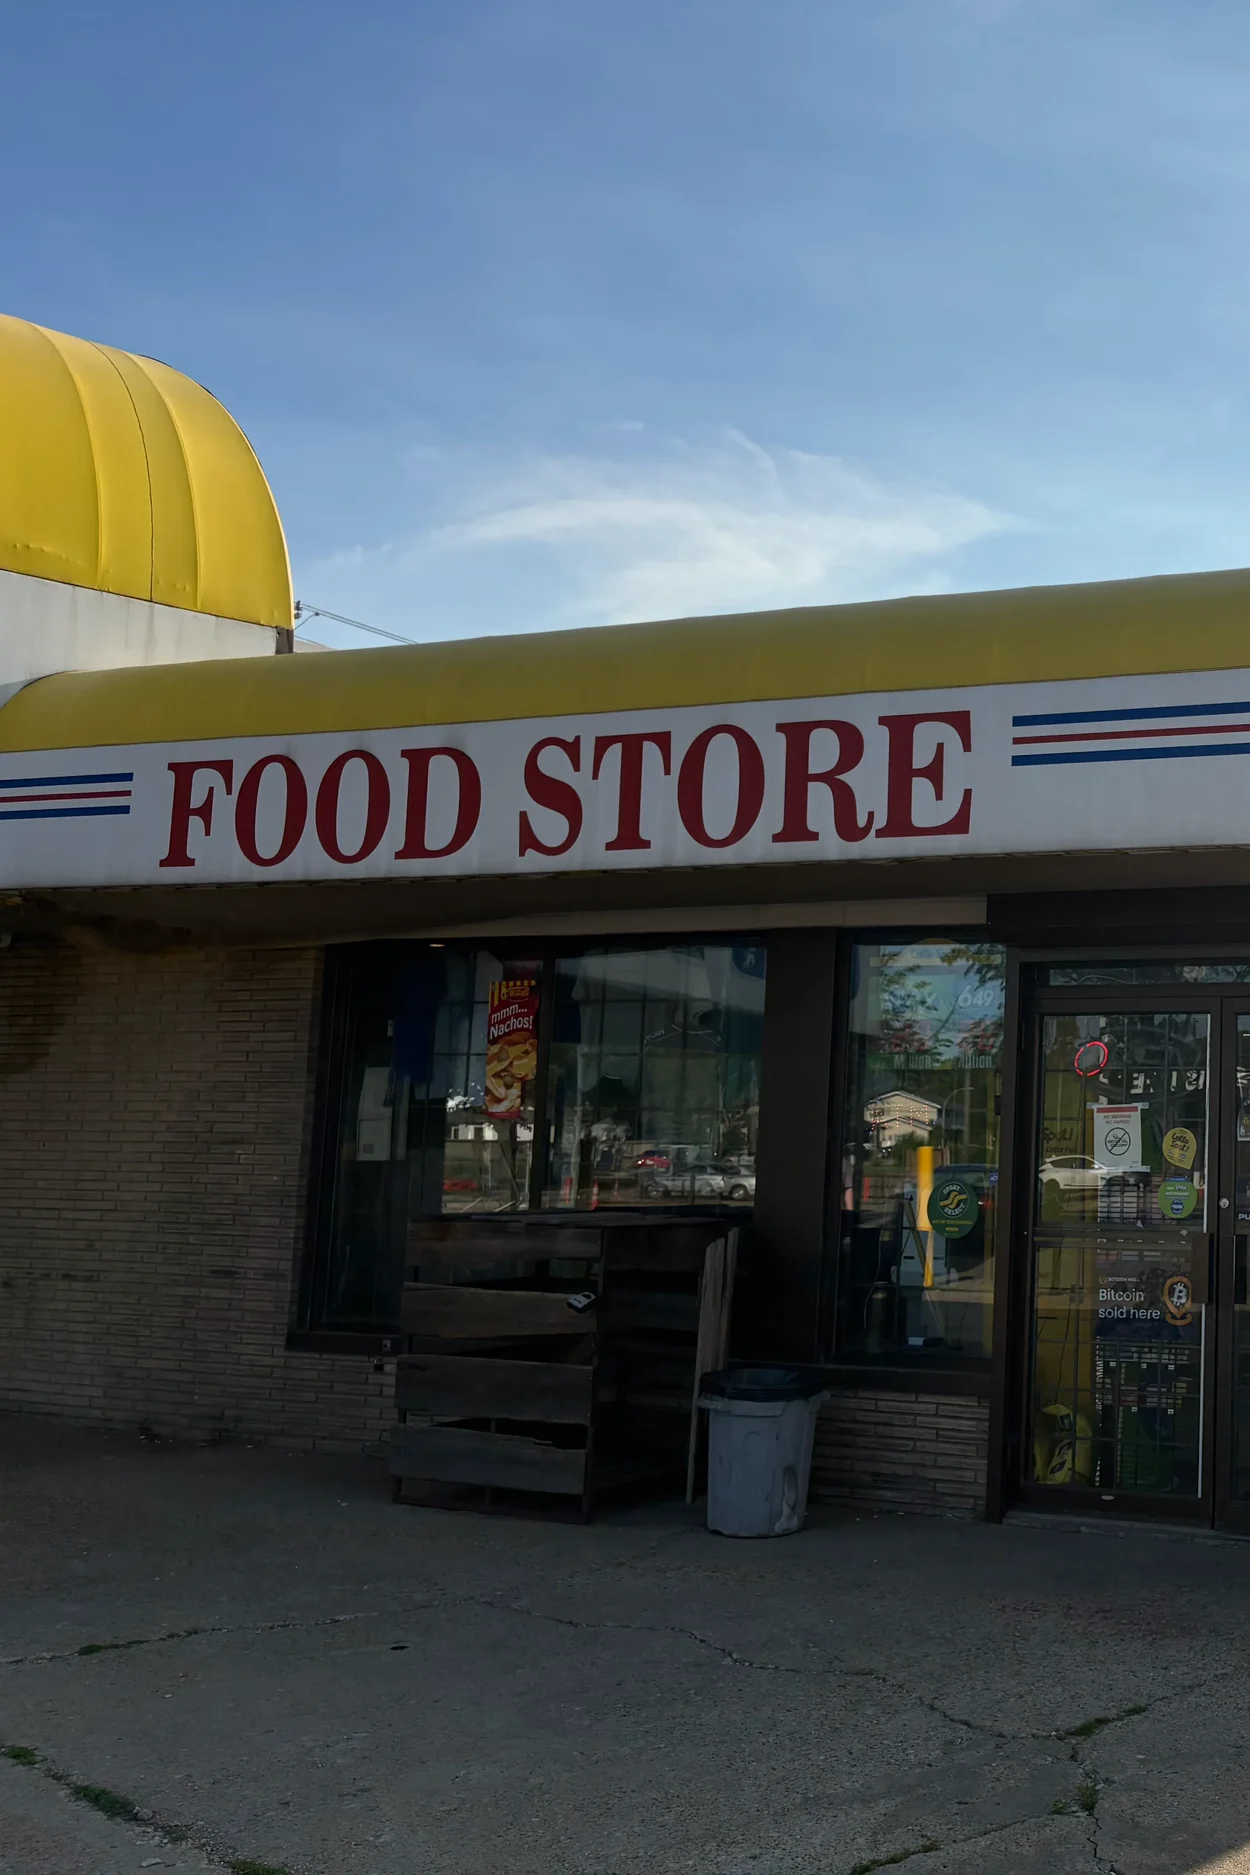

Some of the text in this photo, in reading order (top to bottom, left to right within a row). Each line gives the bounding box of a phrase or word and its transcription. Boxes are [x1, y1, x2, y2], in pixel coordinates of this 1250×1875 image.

[158, 710, 973, 869] FOOD STORE
[957, 985, 994, 1009] 649
[492, 1004, 527, 1024] mmm...
[490, 1015, 533, 1040] Nachos!
[1171, 1132, 1190, 1145] Lotto
[1099, 1288, 1145, 1301] Bitcoin
[1098, 1306, 1160, 1319] sold here
